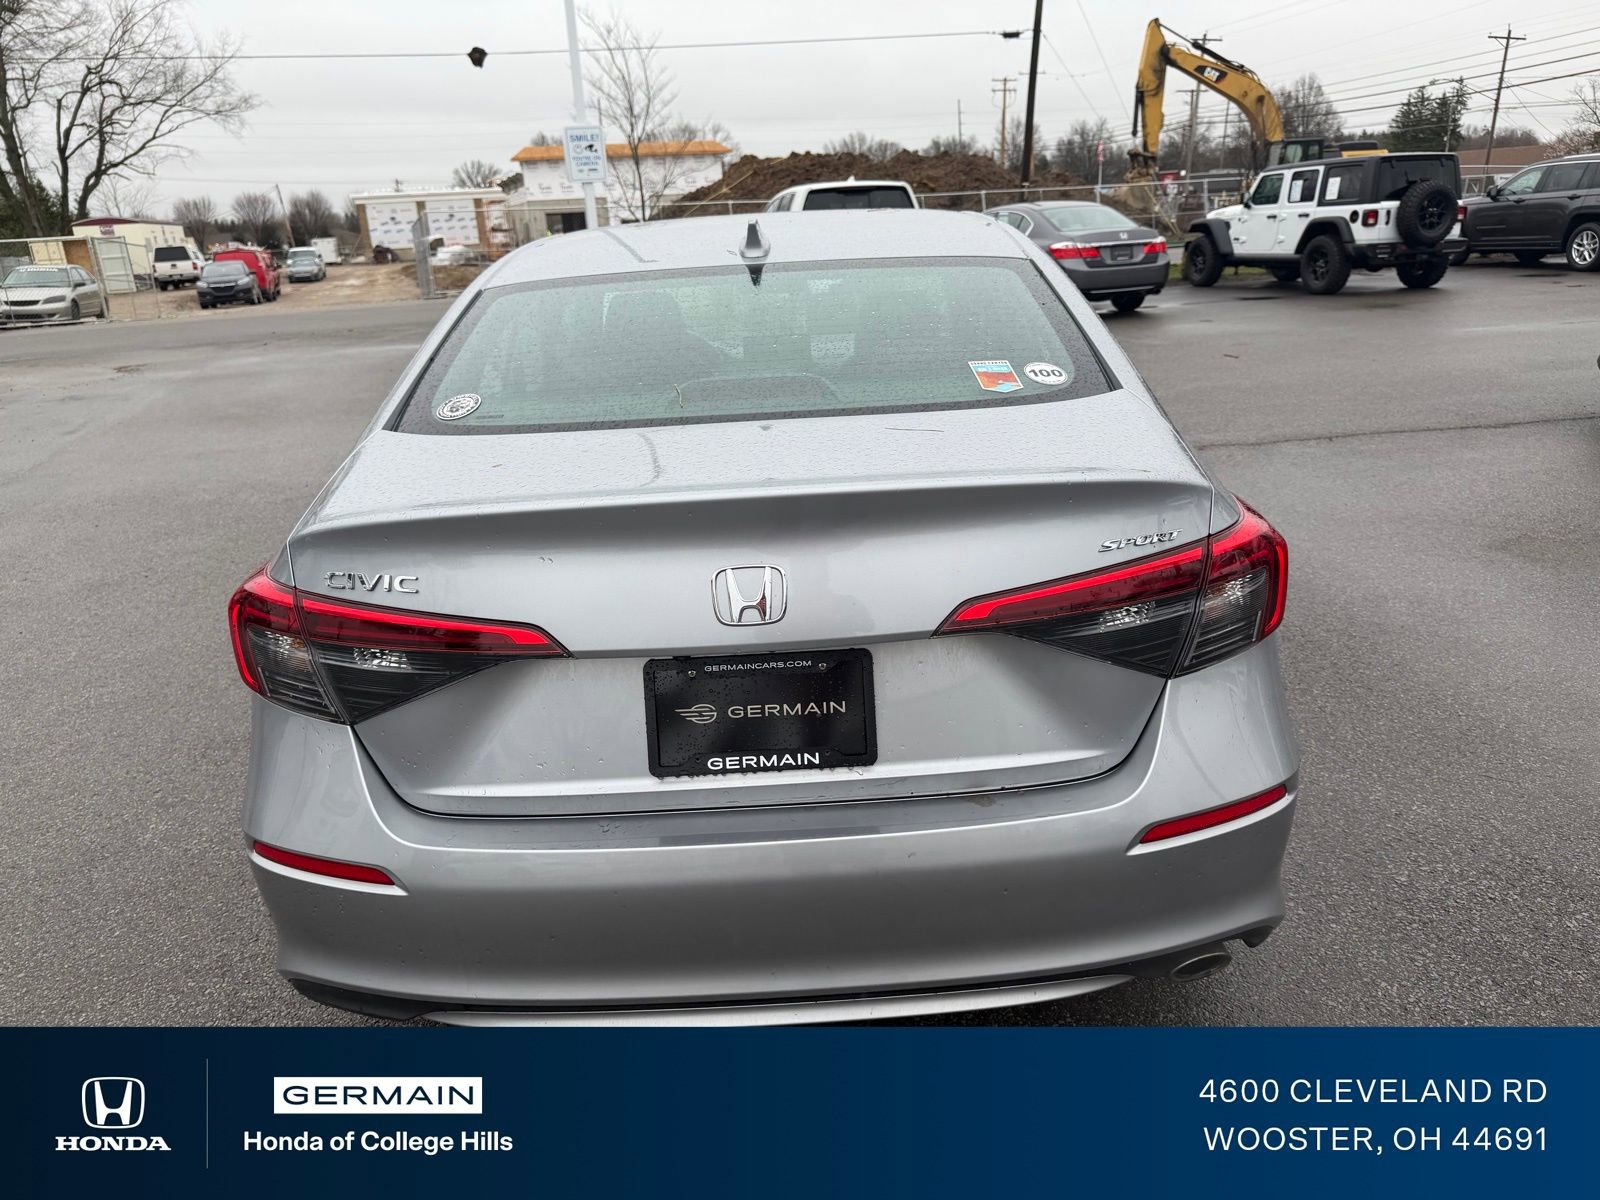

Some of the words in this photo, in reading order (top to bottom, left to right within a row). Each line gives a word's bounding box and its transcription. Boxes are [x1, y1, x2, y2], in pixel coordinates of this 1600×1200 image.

[1028, 368, 1064, 378] 100
[1098, 528, 1183, 553] SPORT
[325, 571, 419, 594] CIVIC
[704, 660, 812, 672] GERMAINCARS.COM
[727, 700, 846, 719] GERMAIN
[707, 752, 820, 771] GERMAIN
